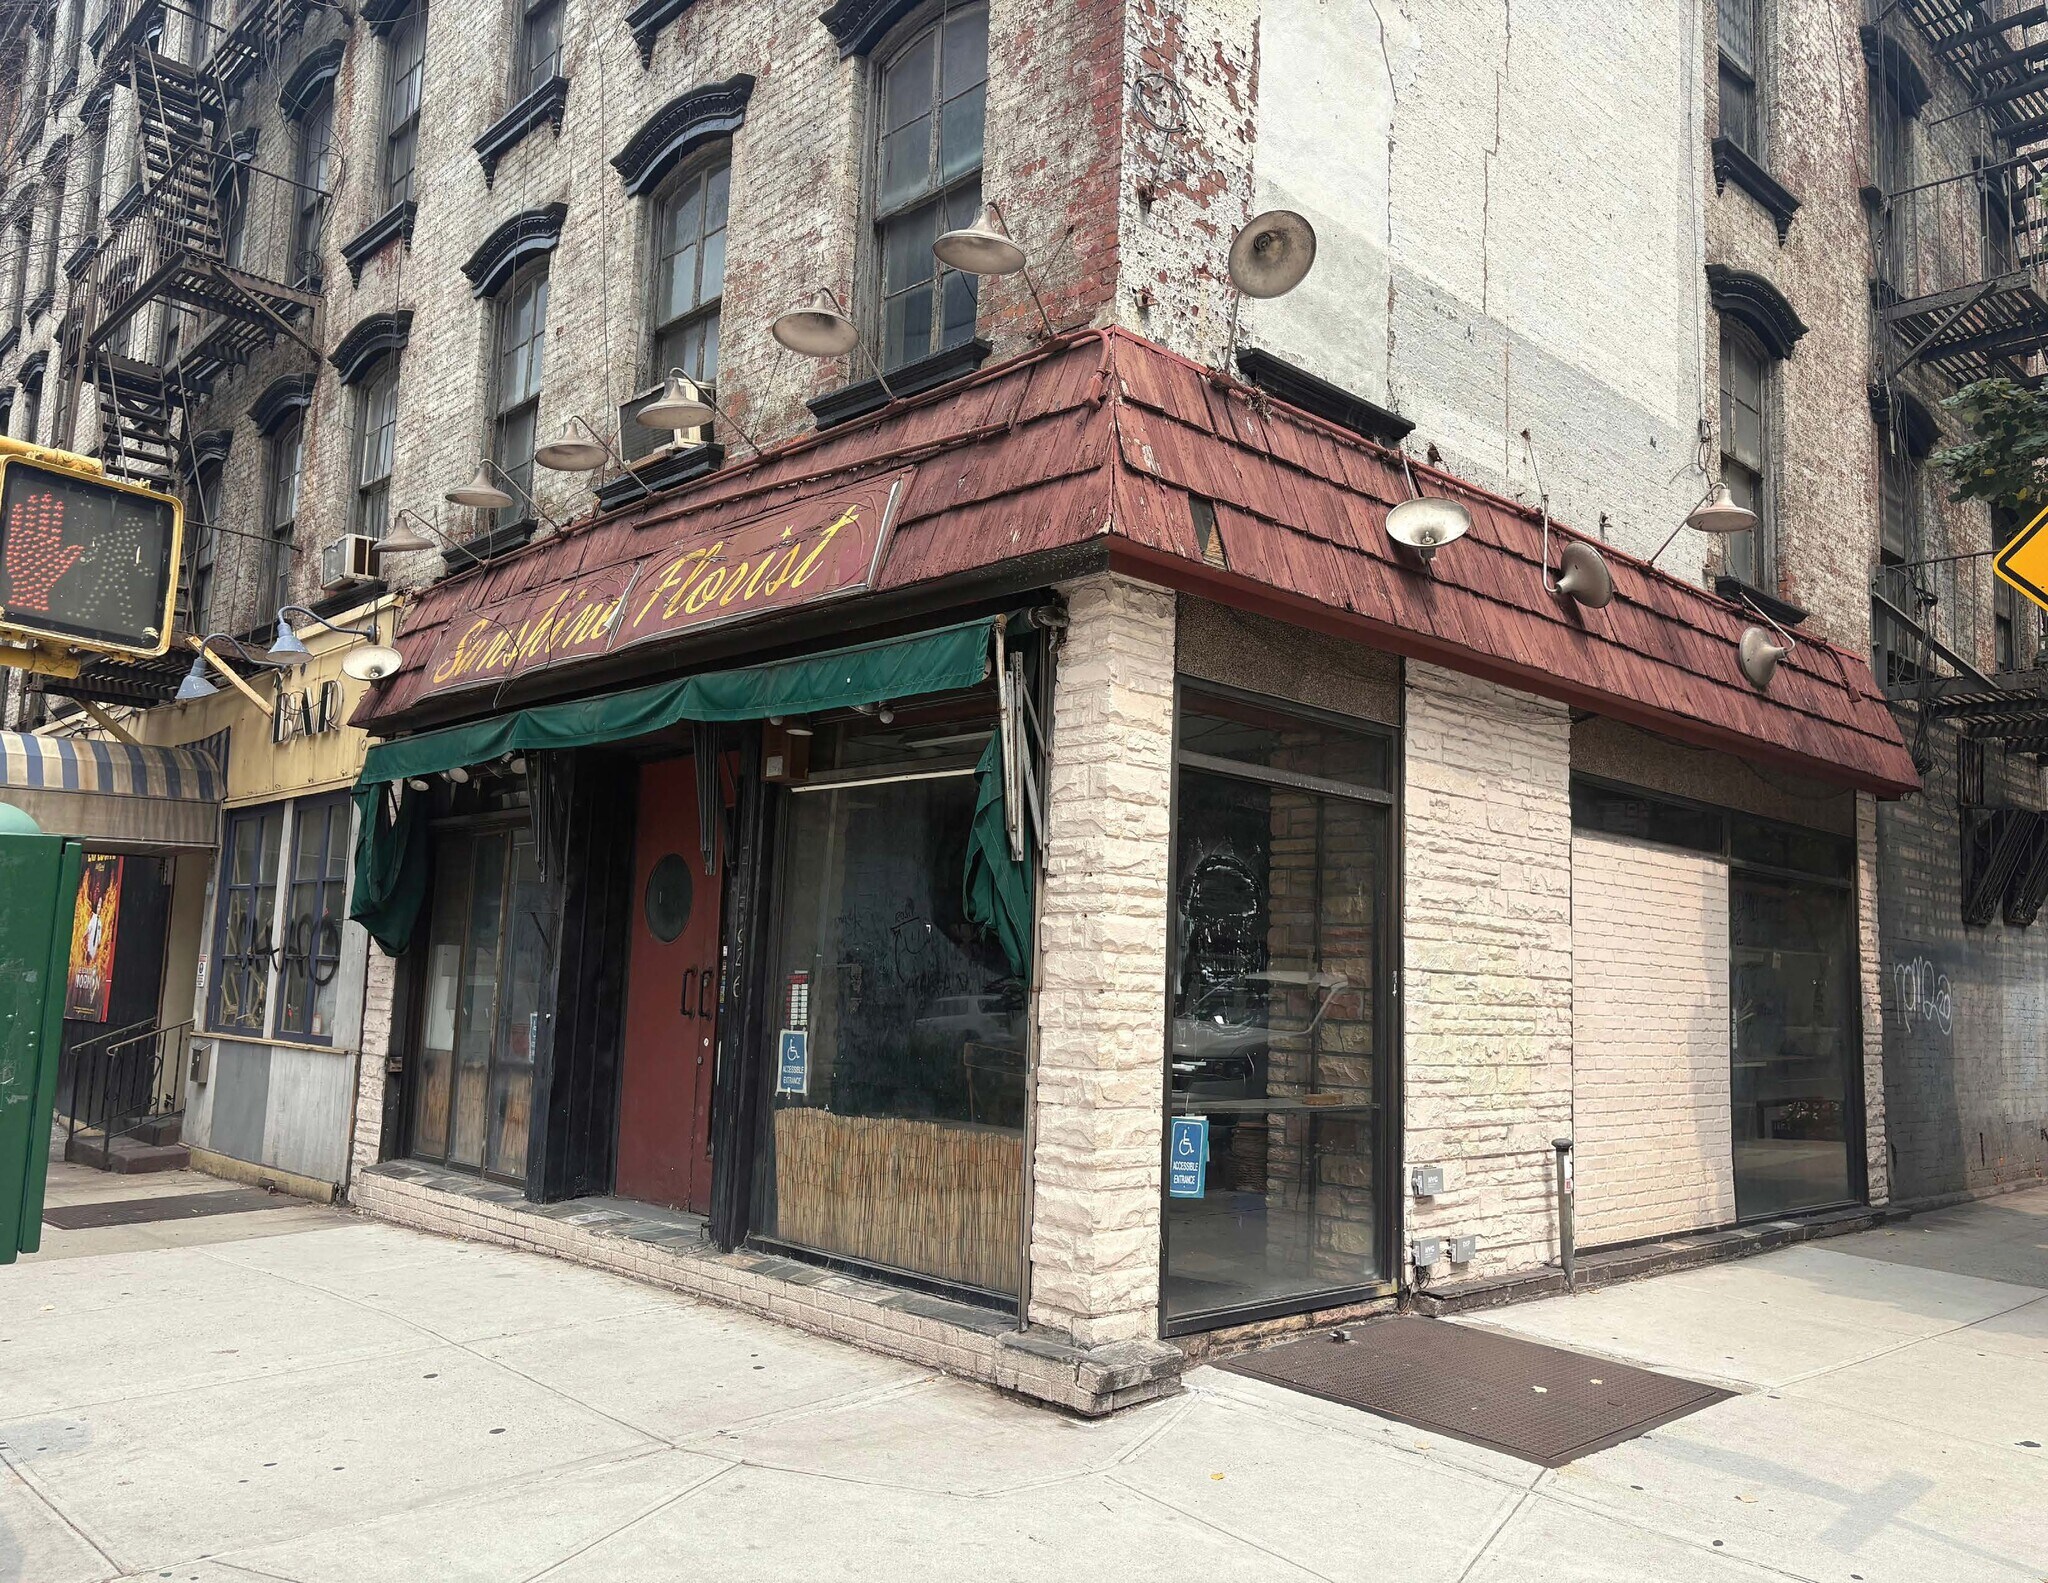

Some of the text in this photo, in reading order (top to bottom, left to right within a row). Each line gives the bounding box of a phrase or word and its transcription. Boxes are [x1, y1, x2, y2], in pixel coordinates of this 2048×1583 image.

[433, 504, 860, 684] Sunshine Florist
[272, 679, 344, 744] BAR
[782, 1065, 804, 1074] ACCESSIBLE
[783, 1076, 802, 1085] ENTRANCE
[1173, 1161, 1198, 1171] ACCESSIBLE
[1174, 1174, 1196, 1184] ENTRANCE
